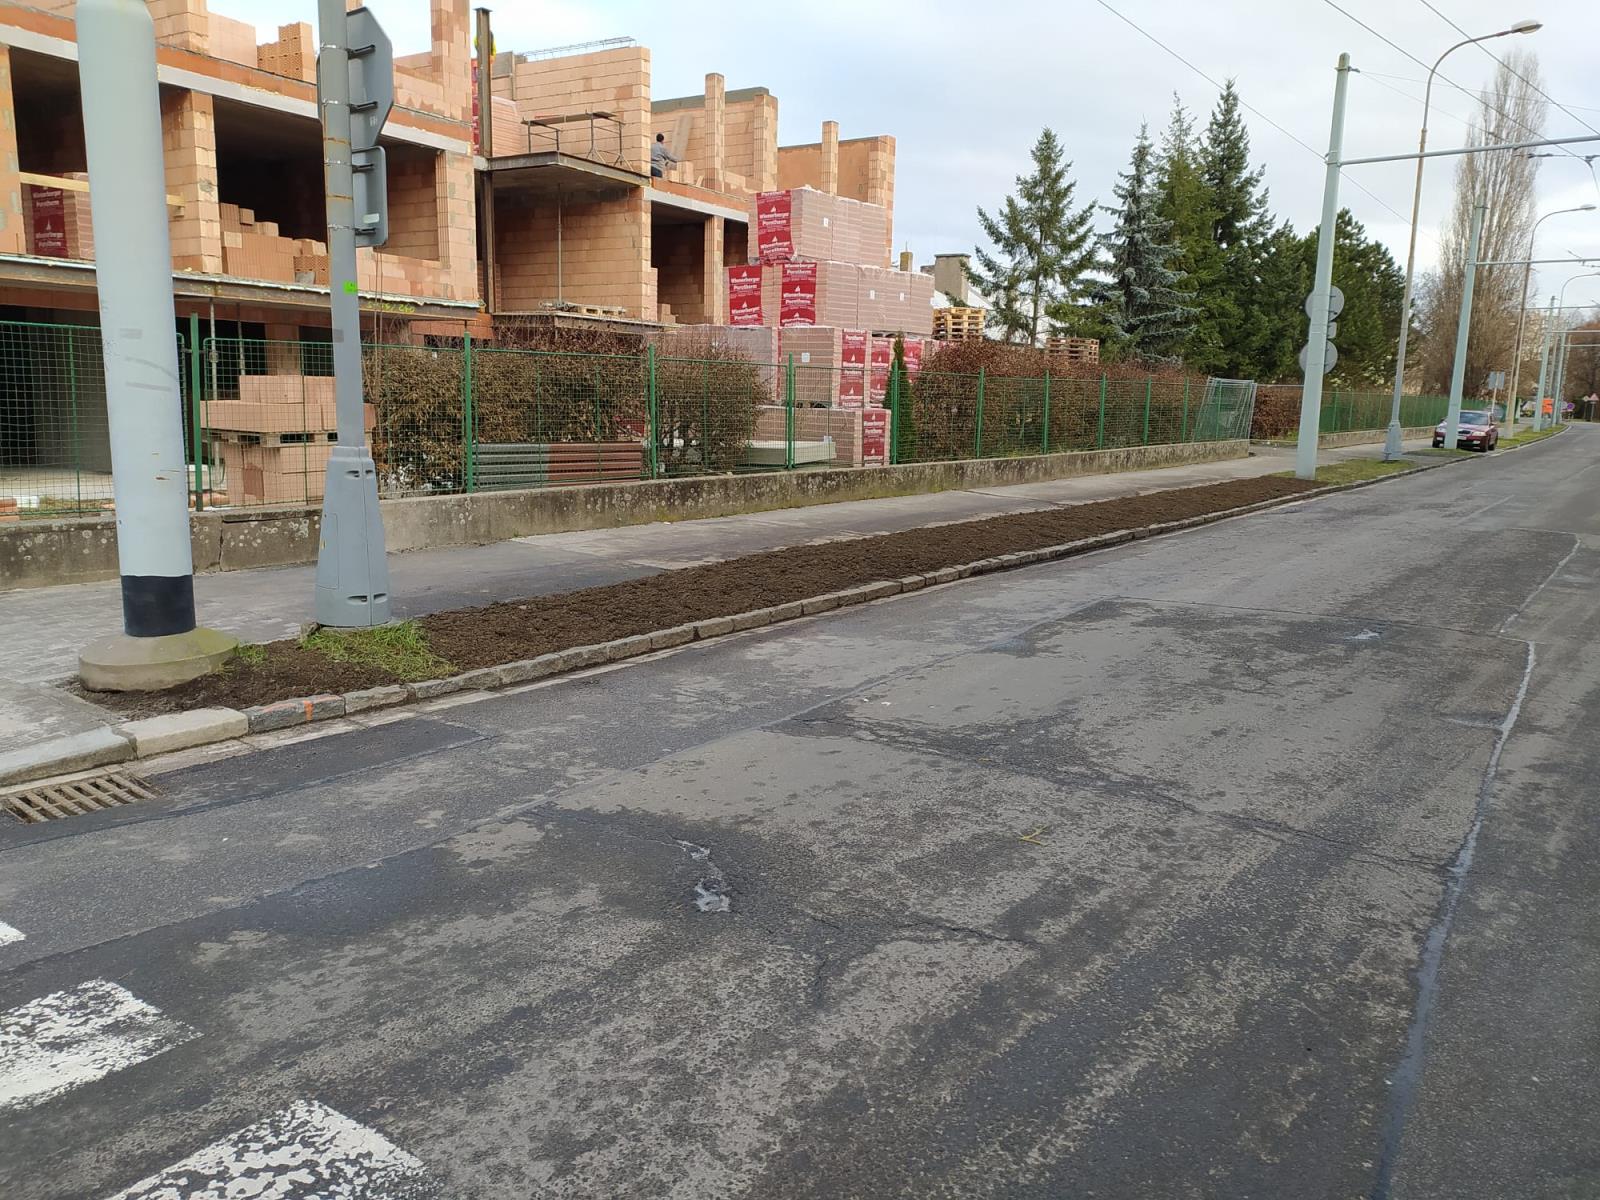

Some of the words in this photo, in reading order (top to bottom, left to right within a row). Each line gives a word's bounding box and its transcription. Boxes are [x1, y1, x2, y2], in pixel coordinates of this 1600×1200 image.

[759, 212, 790, 220] Wienerberger
[783, 292, 814, 300] Wienerberger
[731, 306, 761, 315] Wienerberger
